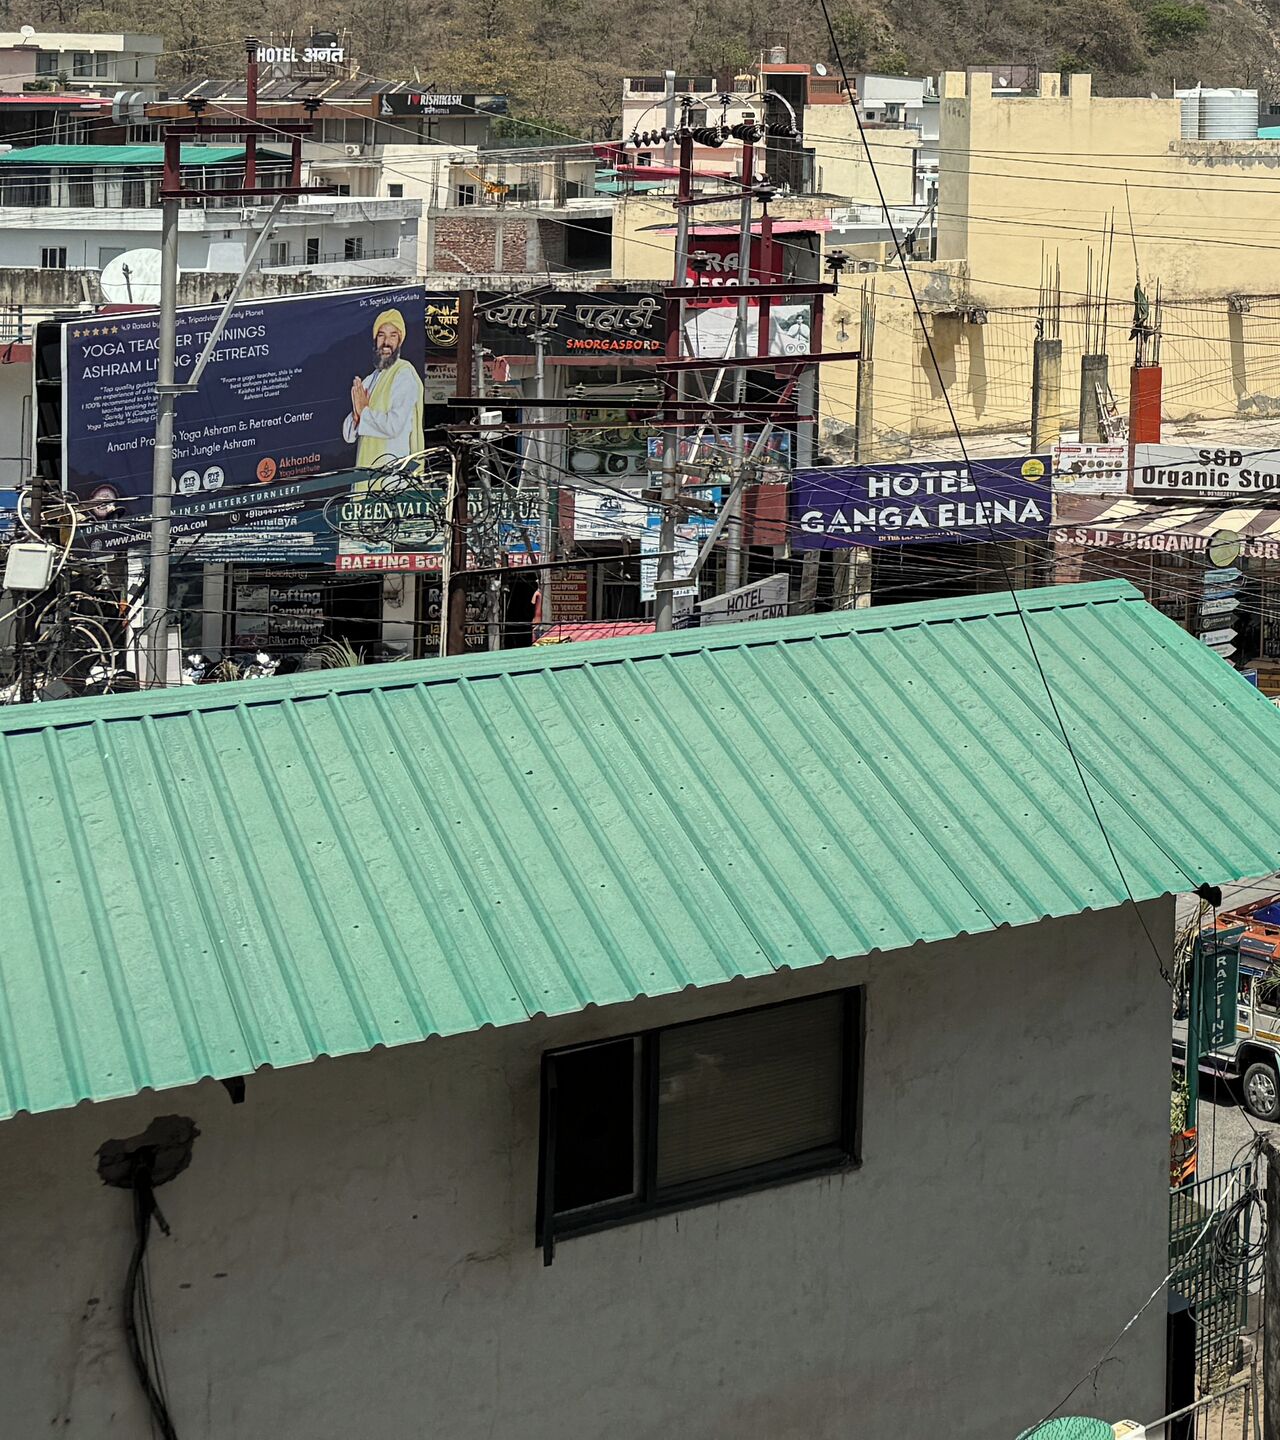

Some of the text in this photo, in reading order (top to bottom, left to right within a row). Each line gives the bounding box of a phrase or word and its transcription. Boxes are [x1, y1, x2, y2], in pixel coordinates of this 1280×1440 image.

[256, 41, 344, 63] HOTEL अनंत
[419, 94, 462, 106] RISHIKESH
[131, 318, 151, 330] Rated
[246, 309, 265, 318] Planet
[575, 297, 662, 336] पहाड़ी
[82, 332, 192, 359] YOGA TEACER
[566, 338, 661, 351] SMORGASBORD
[82, 344, 270, 380] ASHRAM RETREATS
[102, 391, 134, 401] experience
[264, 390, 280, 398] Guest
[86, 416, 150, 432] Yoga Teacher Training
[106, 438, 139, 453] Anand
[178, 430, 202, 444] Yoga
[202, 423, 237, 438] Ashram
[238, 420, 248, 431] &
[249, 415, 283, 430] Retreat
[282, 411, 315, 425] Center
[171, 436, 257, 461] Shri Jungle Ashram
[279, 452, 321, 468] Akhanda
[279, 468, 296, 478] Yoga
[867, 468, 977, 499] HOTEL
[1142, 466, 1230, 488] Organic
[179, 505, 192, 516] IN
[208, 495, 249, 511] METERS
[249, 489, 277, 502] TURN
[279, 485, 302, 496] LEFT
[341, 501, 393, 521] GREEN
[800, 497, 1045, 534] GANGA ELENA
[1055, 527, 1114, 548] S.S.D.
[340, 554, 410, 570] RAFTING
[269, 588, 321, 605] Rafting
[726, 587, 765, 616] HOTEL
[269, 619, 323, 636] Trekking
[299, 634, 320, 646] Rent
[1211, 954, 1229, 1046] RAFTING
